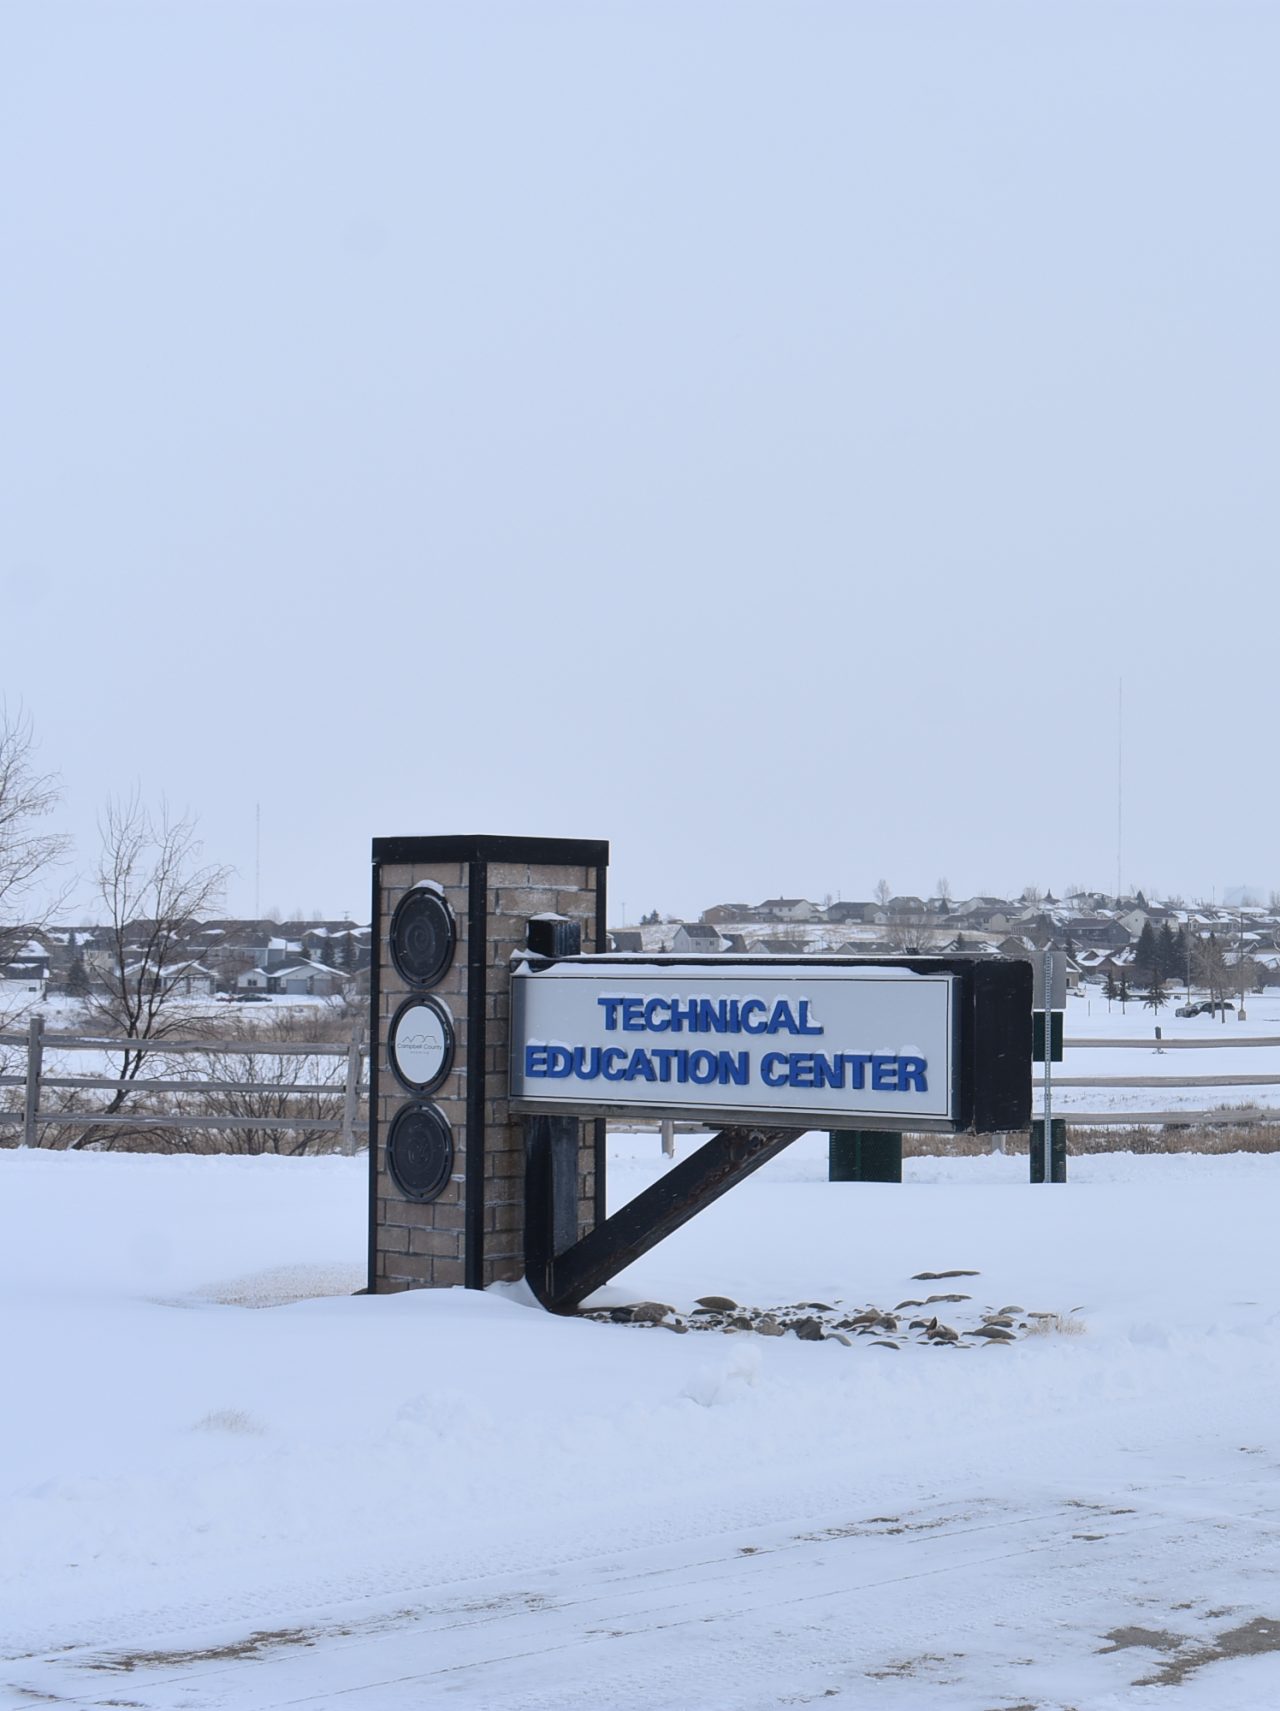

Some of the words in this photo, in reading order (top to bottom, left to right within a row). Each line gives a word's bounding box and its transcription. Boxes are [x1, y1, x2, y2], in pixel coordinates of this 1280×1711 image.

[597, 996, 824, 1035] TECHNICAL
[525, 1044, 750, 1086] EDUCATION
[760, 1051, 929, 1092] CENTER
